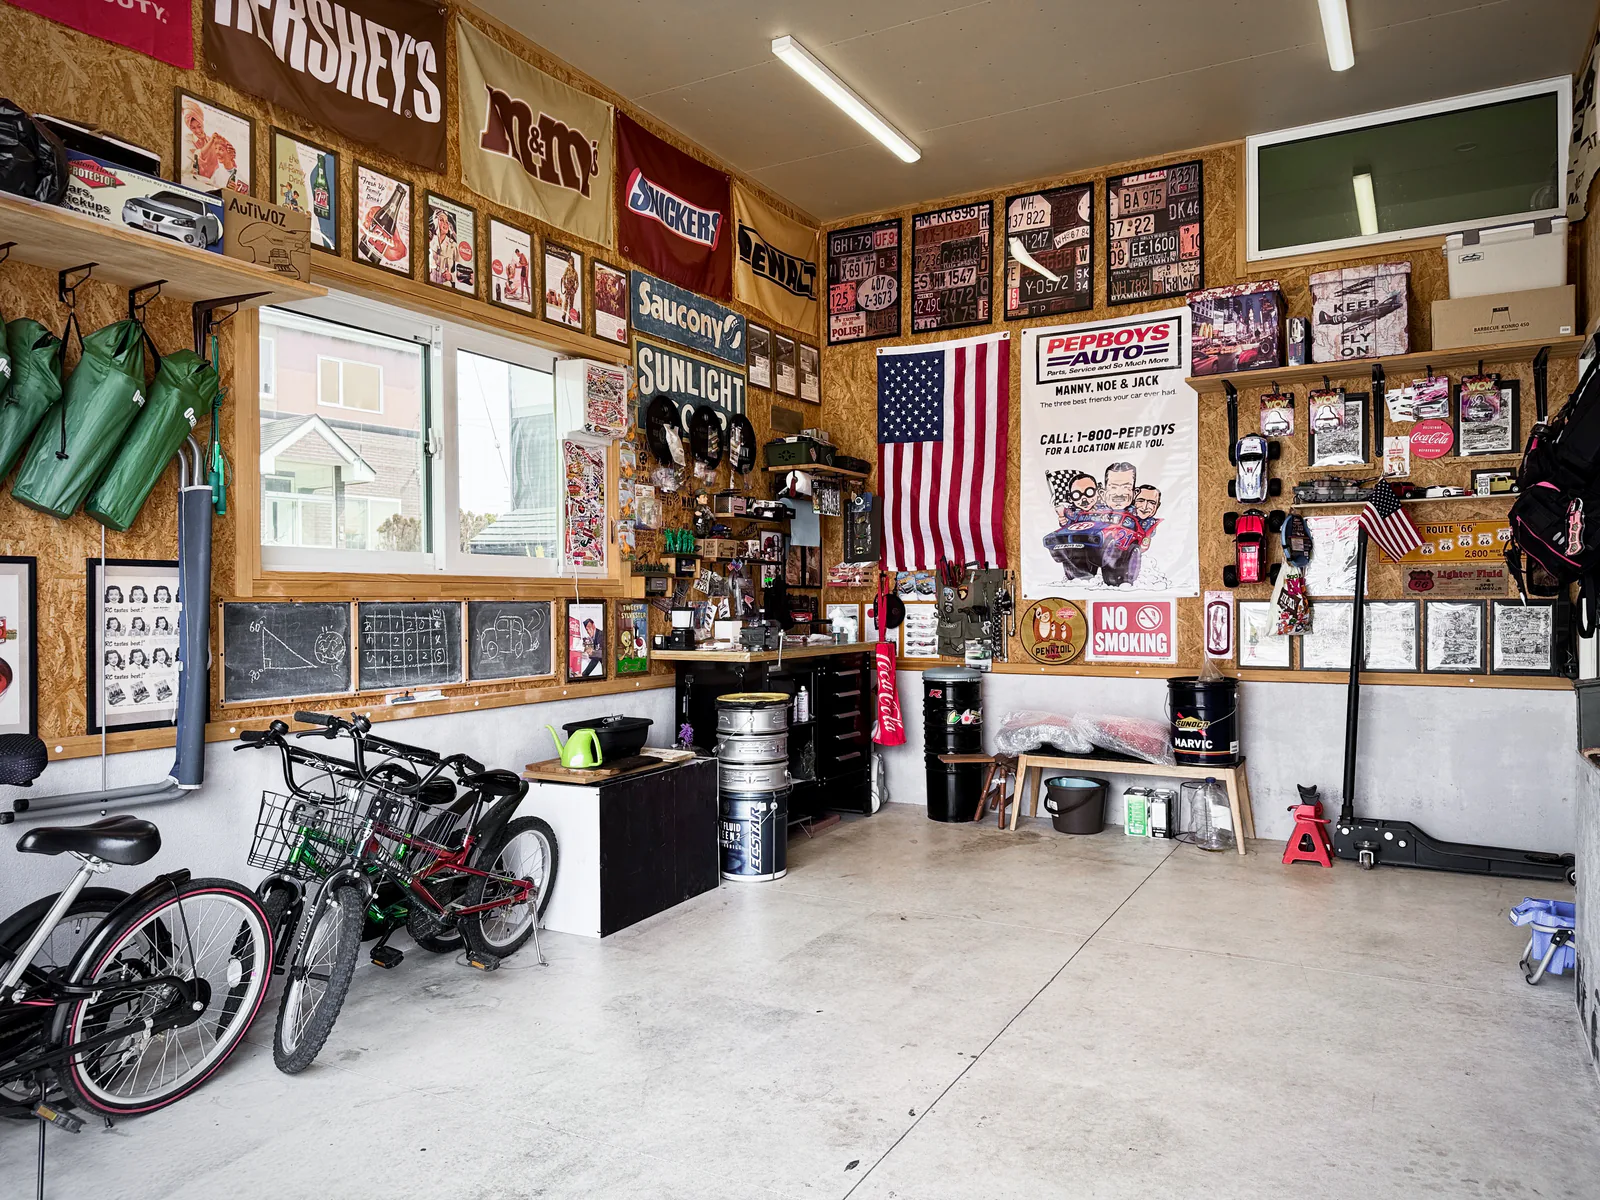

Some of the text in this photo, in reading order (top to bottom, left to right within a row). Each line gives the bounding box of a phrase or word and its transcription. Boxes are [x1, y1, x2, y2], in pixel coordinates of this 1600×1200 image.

[103, 0, 167, 24] UTY.
[69, 184, 95, 201] ars,
[66, 192, 111, 215] ickups
[832, 325, 865, 338] POLISH
[1047, 324, 1169, 354] PEPBOYS
[1341, 332, 1370, 345] FLY
[1070, 344, 1144, 366] AUTO
[1340, 346, 1370, 357] ON
[1047, 369, 1067, 377] Parts,
[1069, 365, 1096, 374] Service
[1125, 359, 1146, 367] Much
[1120, 378, 1128, 388] &
[1131, 375, 1159, 388] JACK
[1072, 398, 1087, 406] best
[1088, 395, 1112, 404] friends
[1113, 394, 1128, 402] your
[1040, 423, 1175, 445] CALL: 1-800-PEPBOYS
[1410, 431, 1450, 444] Coca-Cola
[1045, 446, 1061, 455] FOR
[1072, 442, 1116, 454] LOCATION
[1118, 441, 1142, 449] NEAR
[1144, 439, 1164, 448] YOU.
[1426, 525, 1453, 534] ROUTE
[1437, 570, 1474, 579] Lighter
[1477, 569, 1503, 578] Fluid
[1101, 606, 1128, 631] NO
[1095, 632, 1167, 653] SMOKING
[1036, 645, 1071, 655] PENNZOIL
[1176, 720, 1209, 728] SUNOCO
[1174, 737, 1213, 749] MARVIC
